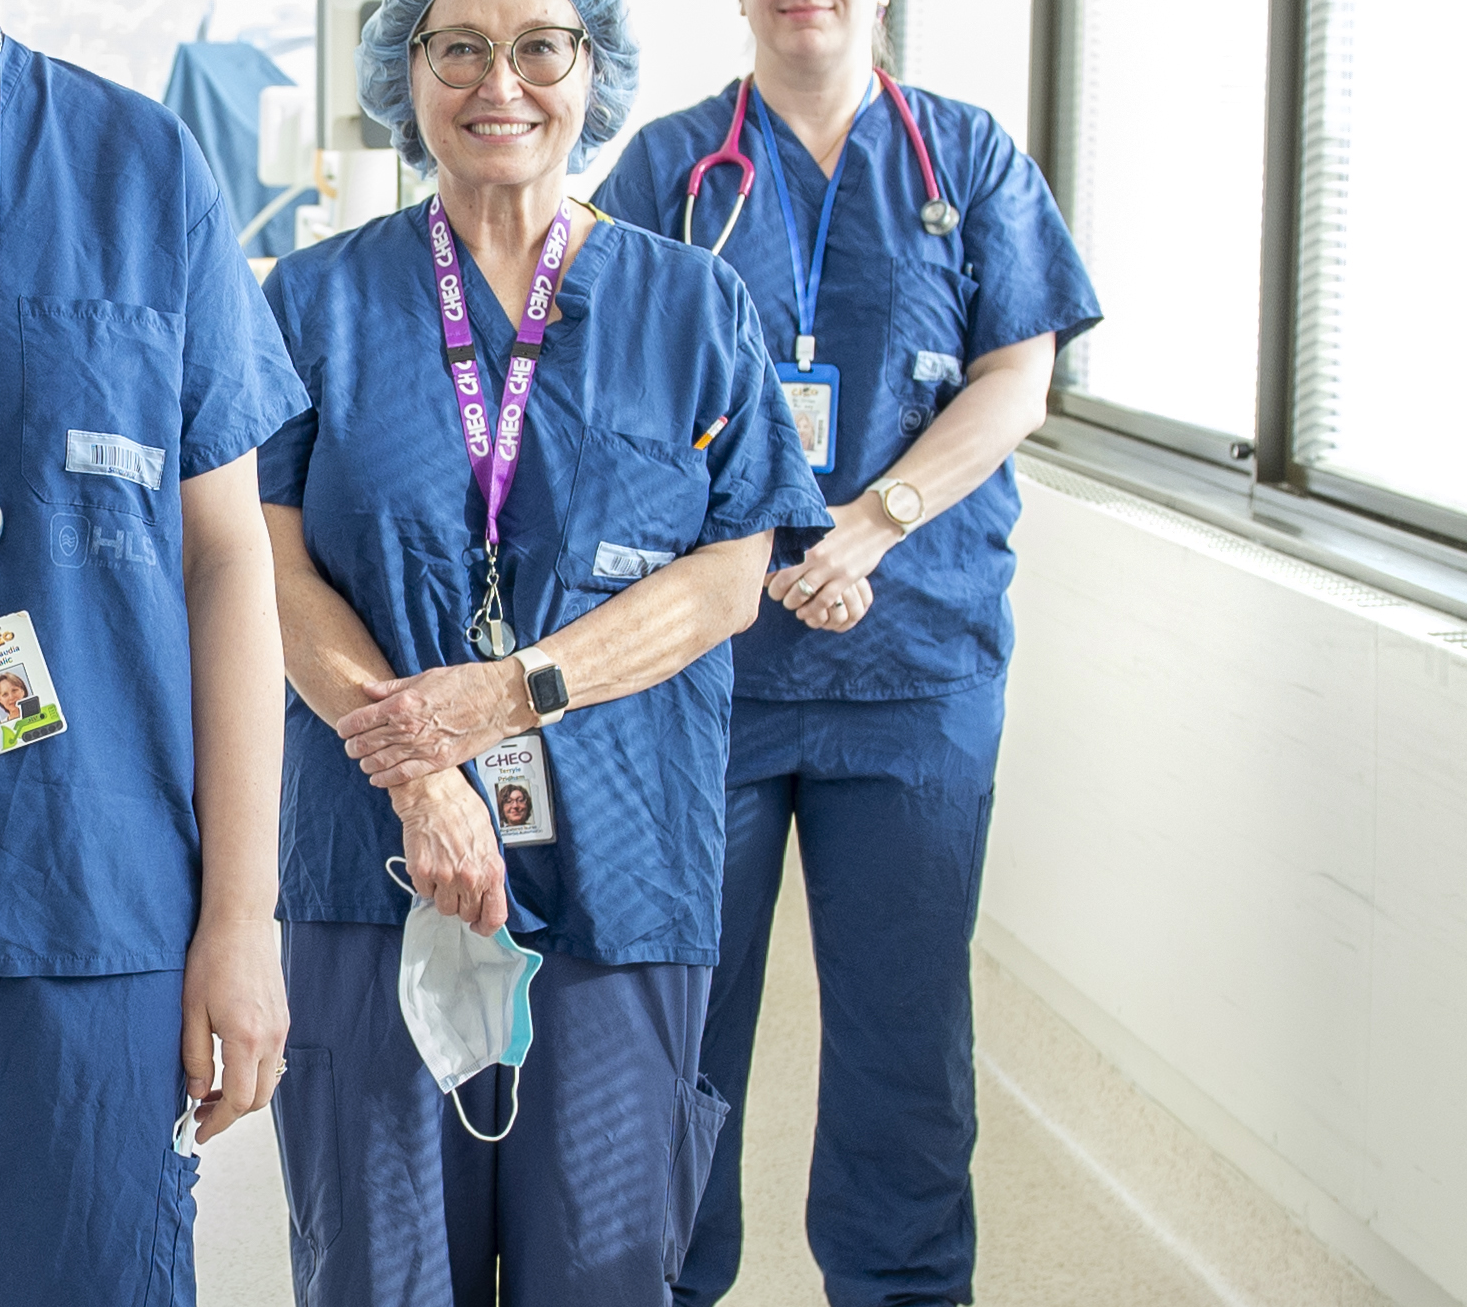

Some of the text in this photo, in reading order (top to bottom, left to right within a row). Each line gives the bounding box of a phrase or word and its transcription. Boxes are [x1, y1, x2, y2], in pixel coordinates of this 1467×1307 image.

[432, 221, 454, 268] CHEO
[543, 222, 568, 269] CHEO
[439, 274, 464, 321] CHEO
[527, 274, 553, 321] CHEO
[508, 357, 533, 395] CHE
[463, 402, 490, 458] CHEO
[498, 403, 523, 462] CHEO
[485, 751, 533, 767] CHEO
